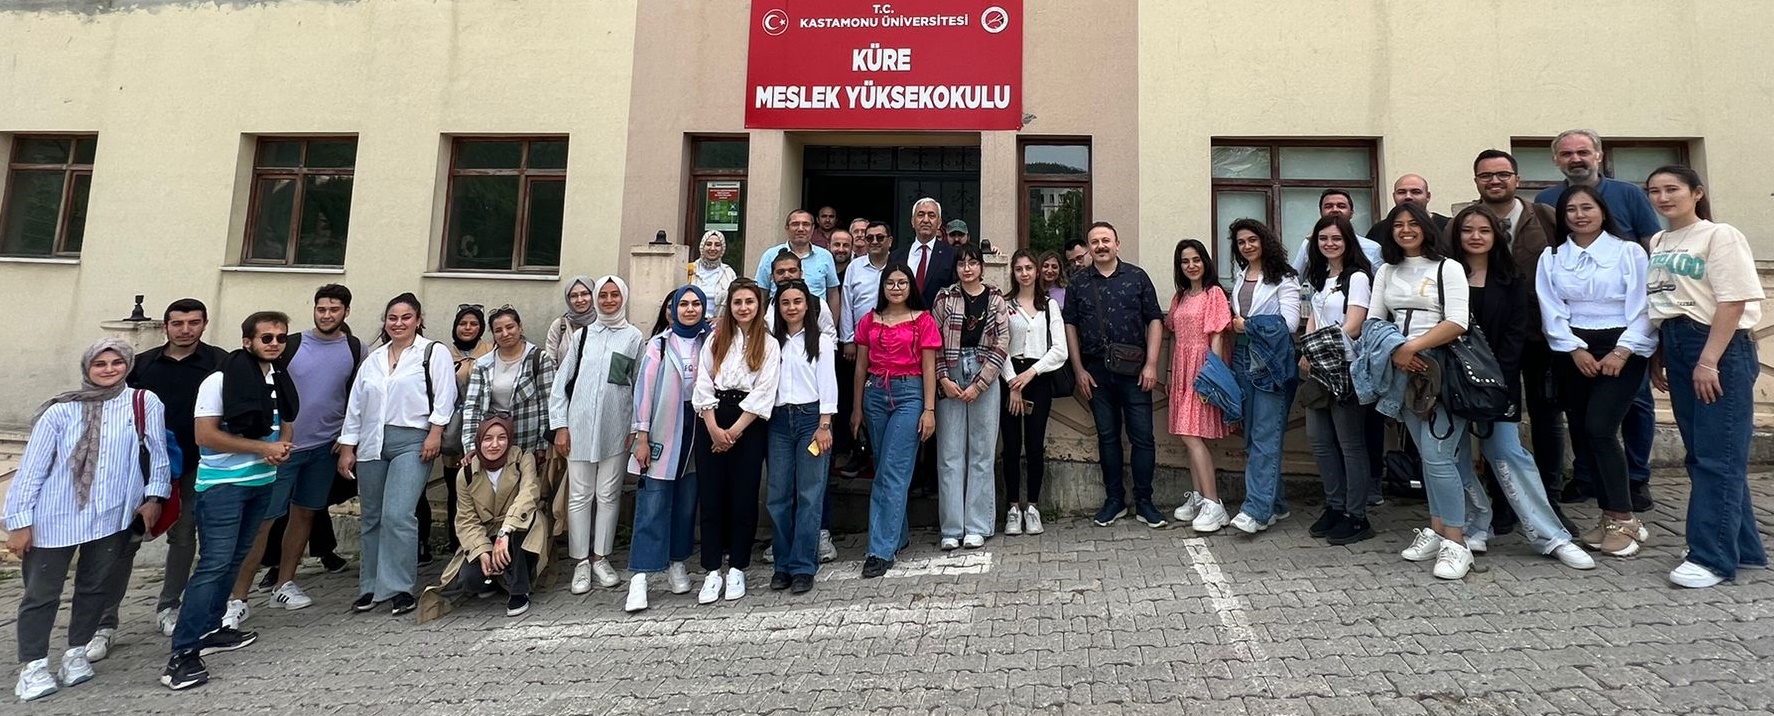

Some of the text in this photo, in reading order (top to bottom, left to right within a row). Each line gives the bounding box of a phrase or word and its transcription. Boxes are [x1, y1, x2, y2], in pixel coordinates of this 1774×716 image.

[872, 4, 895, 14] T.C.
[799, 17, 879, 28] KASTAMONU
[881, 14, 969, 27] ÜNİVERSİTESİ
[852, 42, 912, 72] KÜRE
[755, 80, 1011, 109] MESLEK YÜKSEKOKULU
